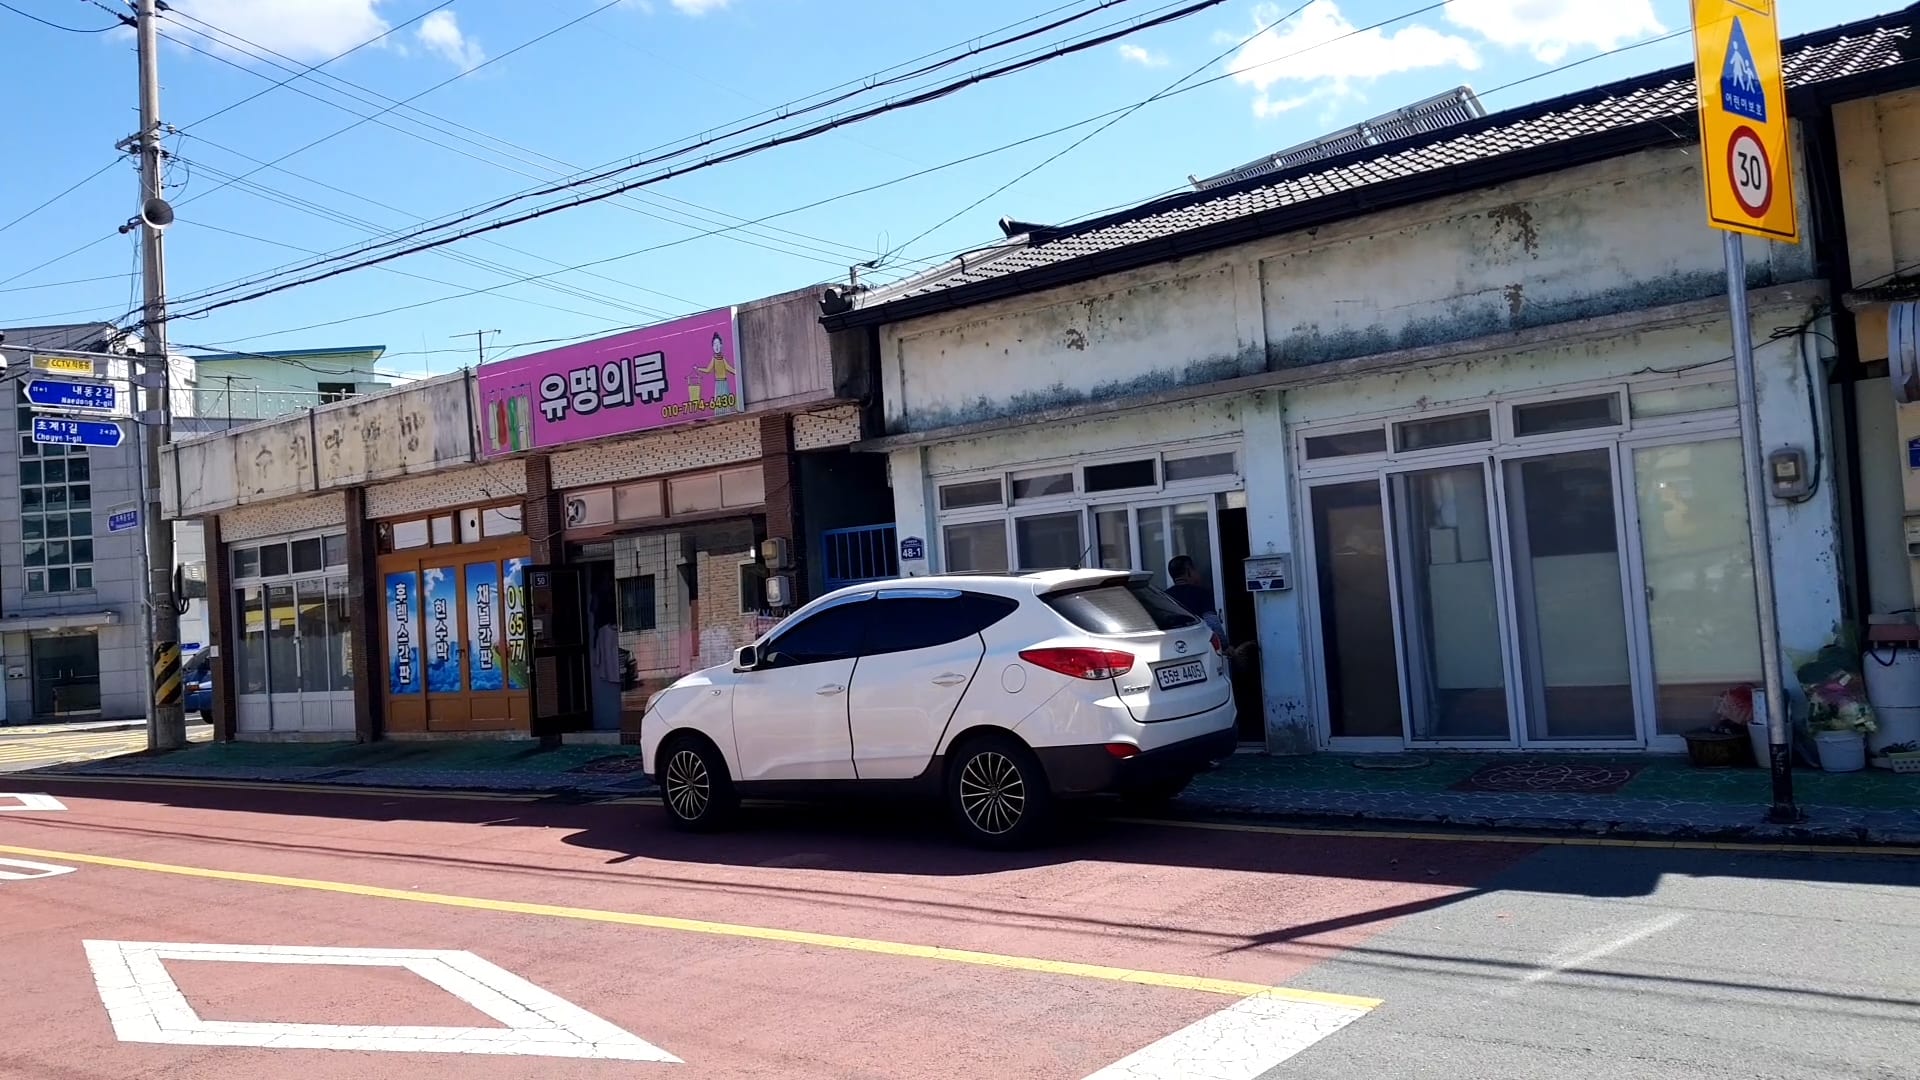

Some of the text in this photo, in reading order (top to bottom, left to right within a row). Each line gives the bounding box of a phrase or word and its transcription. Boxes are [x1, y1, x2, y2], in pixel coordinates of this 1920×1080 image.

[1738, 151, 1762, 190] 30
[51, 359, 71, 368] CCTV
[72, 385, 113, 399] 내동2길
[539, 350, 669, 421] 유명의류
[661, 394, 735, 419] 010-7174-6430
[36, 421, 78, 435] 초계1길
[902, 547, 921, 558] 48-1
[395, 582, 412, 685] 후렉스간판
[434, 598, 450, 662] 현수막
[476, 583, 493, 670] 채널간판
[1182, 664, 1203, 681] 4405
